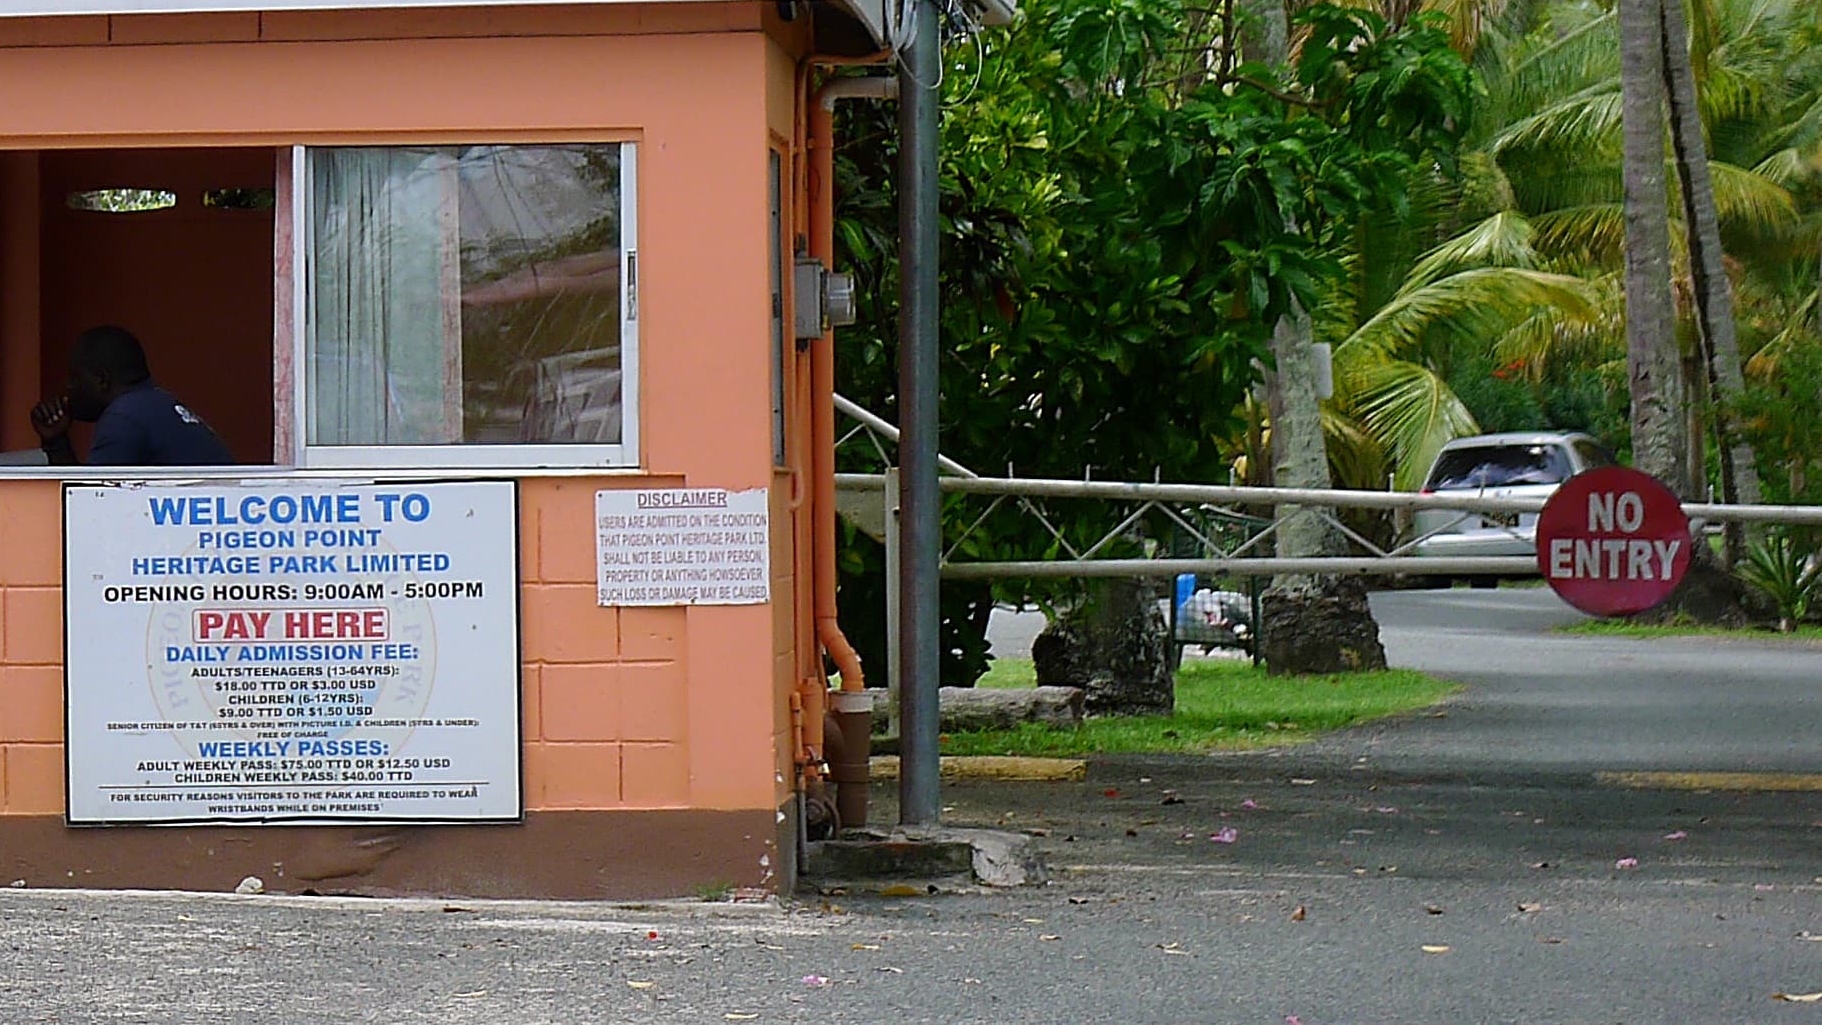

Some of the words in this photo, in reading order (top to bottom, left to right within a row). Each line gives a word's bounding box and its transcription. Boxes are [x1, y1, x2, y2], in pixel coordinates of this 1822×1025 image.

[637, 492, 727, 506] DISCLAIMER
[149, 494, 360, 525] WELCOME
[374, 493, 431, 522] TO
[1588, 491, 1644, 533] NO
[599, 516, 626, 529] USERS
[628, 516, 645, 528] ARE
[646, 515, 688, 528] ADMITTED
[690, 515, 702, 528] ON
[704, 515, 720, 527] THE
[722, 514, 767, 527] CONDITION
[199, 531, 294, 549] PIGEON
[304, 530, 382, 547] POINT
[600, 534, 620, 547] THAT
[622, 534, 654, 546] PIGEON
[656, 534, 680, 546] POINT
[682, 533, 724, 546] HERITAGE
[725, 532, 748, 545] PARK
[132, 556, 260, 575] HERITAGE
[270, 556, 338, 574] PARK
[346, 554, 450, 572] LIMITED
[604, 552, 631, 565] SHALL
[632, 552, 650, 564] NOT
[651, 551, 662, 564] BE
[664, 551, 694, 564] LIABLE
[696, 551, 706, 564] TO
[708, 551, 726, 563] ANY
[1550, 539, 1681, 581] ENTRY
[606, 570, 650, 582] PROPERTY
[651, 569, 664, 582] OR
[665, 569, 707, 582] ANYTHING
[104, 586, 204, 602] OPENING
[213, 585, 298, 601] HOURS:
[305, 584, 384, 600] 9:00AM
[405, 582, 484, 599] 5:00PM
[600, 588, 623, 600] SUCH
[624, 588, 646, 600] LOSS
[648, 587, 661, 600] OR
[662, 587, 698, 600] DAMAGE
[700, 586, 718, 599] MAY
[719, 586, 731, 599] BE
[199, 612, 271, 639] PAY
[284, 611, 384, 638] HERE
[166, 646, 230, 662] DAILY
[238, 644, 363, 662] ADMISSION
[372, 644, 418, 660] FEE:
[191, 666, 323, 677] ADULTS/TEENAGERS
[327, 665, 400, 676] (13-64YRS):
[215, 681, 256, 691] $18.00
[261, 681, 286, 691] TTD
[290, 680, 308, 690] OR
[312, 680, 345, 690] $3.00
[350, 679, 376, 690] USD
[228, 694, 294, 705] CHILDREN
[298, 694, 364, 705] (6-12YRS):
[218, 707, 254, 718] $9.00
[257, 707, 282, 718] TTD
[286, 706, 304, 717] OR
[308, 706, 342, 717] $1.50
[346, 706, 373, 717] USD
[198, 742, 291, 758] WEEKLY
[298, 740, 389, 756] PASSES:
[137, 762, 179, 771] ADULT
[184, 761, 236, 771] WEEKLY
[240, 761, 276, 770] PASS:
[280, 760, 322, 770] $75.00
[326, 760, 351, 770] TTD
[356, 760, 374, 769] OR
[378, 759, 420, 769] $12.50
[424, 759, 450, 769] USD
[174, 773, 240, 783] CHILDREN
[244, 772, 298, 782] WEEKLY
[302, 772, 338, 782] PASS:
[342, 772, 384, 781] $40.00
[388, 771, 412, 781] TTD
